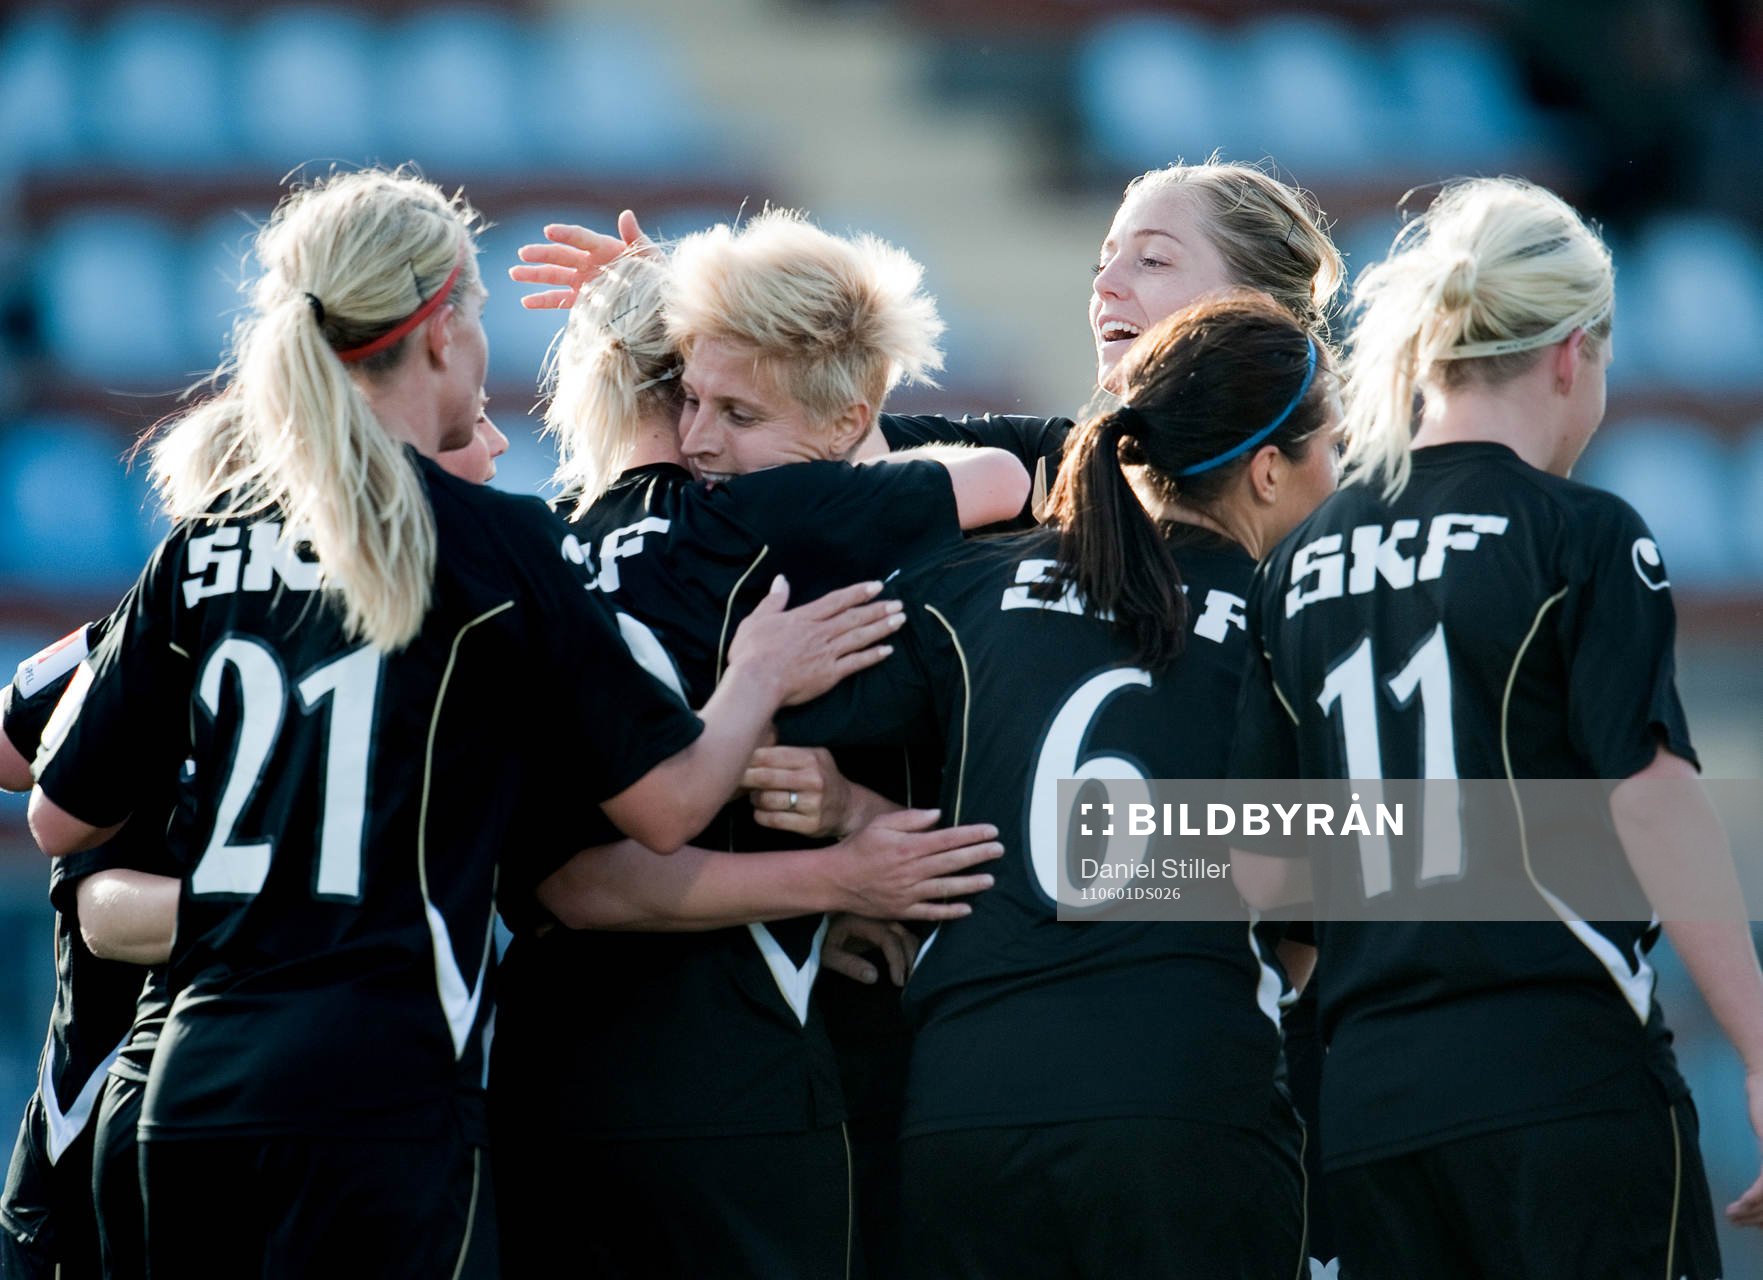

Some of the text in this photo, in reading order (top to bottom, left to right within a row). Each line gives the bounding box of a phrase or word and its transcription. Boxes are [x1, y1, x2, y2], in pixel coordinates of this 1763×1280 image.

[182, 521, 345, 609] SK
[1001, 559, 1247, 644] SF
[1286, 513, 1509, 619] SKF
[191, 637, 383, 898] 21
[1028, 666, 1153, 909] 6
[1316, 621, 1465, 900] 11
